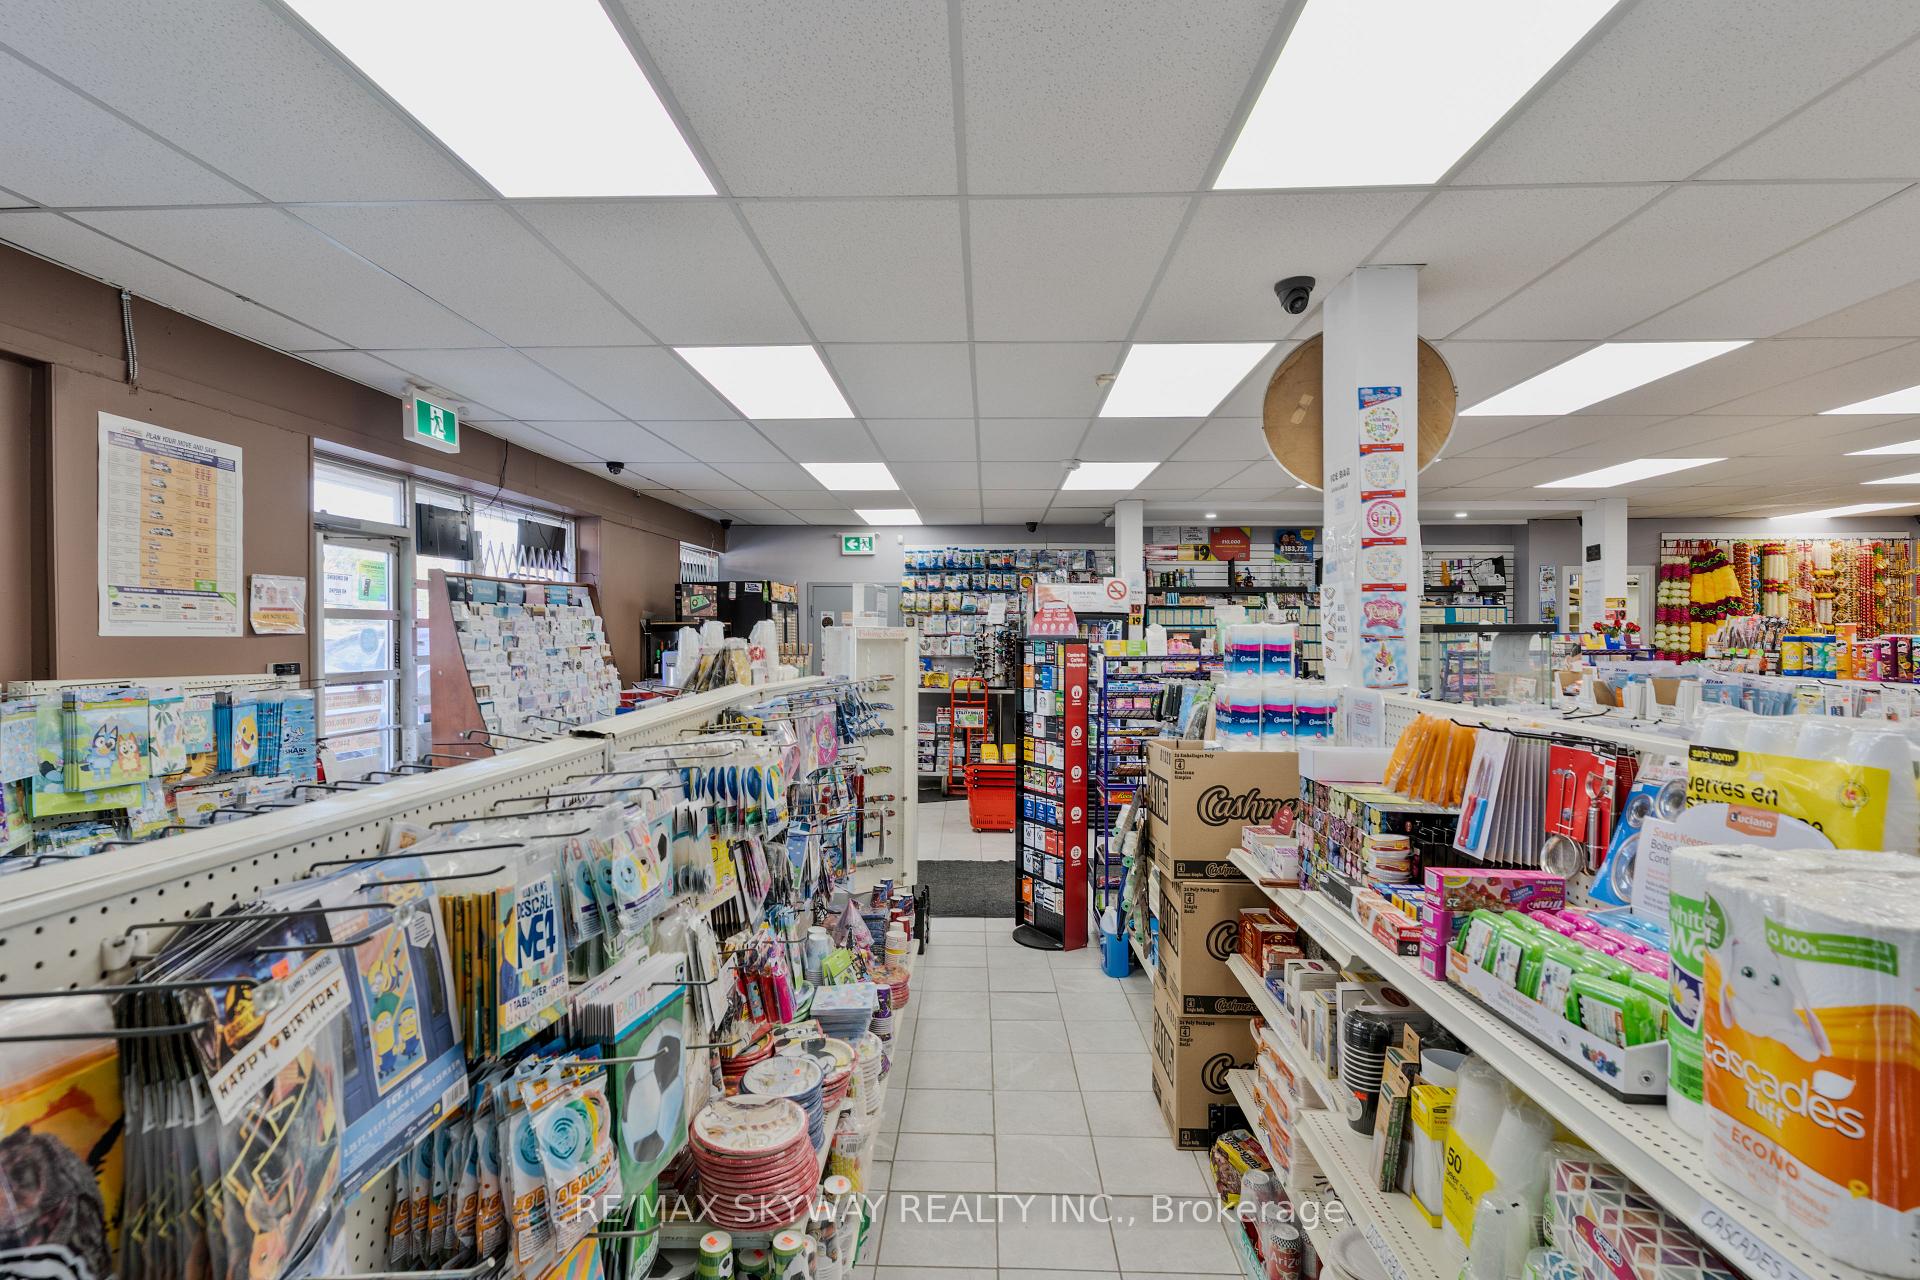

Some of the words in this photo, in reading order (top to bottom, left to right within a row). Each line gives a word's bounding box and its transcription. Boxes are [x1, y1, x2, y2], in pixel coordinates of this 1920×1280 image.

[1132, 616, 1141, 625] 19
[1751, 787, 1778, 806] en
[1446, 898, 1460, 907] 25
[1406, 943, 1418, 952] 40
[217, 1043, 270, 1099] HAPPY
[282, 978, 343, 1041] BIRTHDAY
[1704, 1035, 1866, 1141] cascades
[1744, 1085, 1787, 1130] Tuff
[1447, 1147, 1462, 1174] 50
[1731, 1127, 1799, 1182] ECONO
[1701, 1210, 1783, 1280] CASCADES
